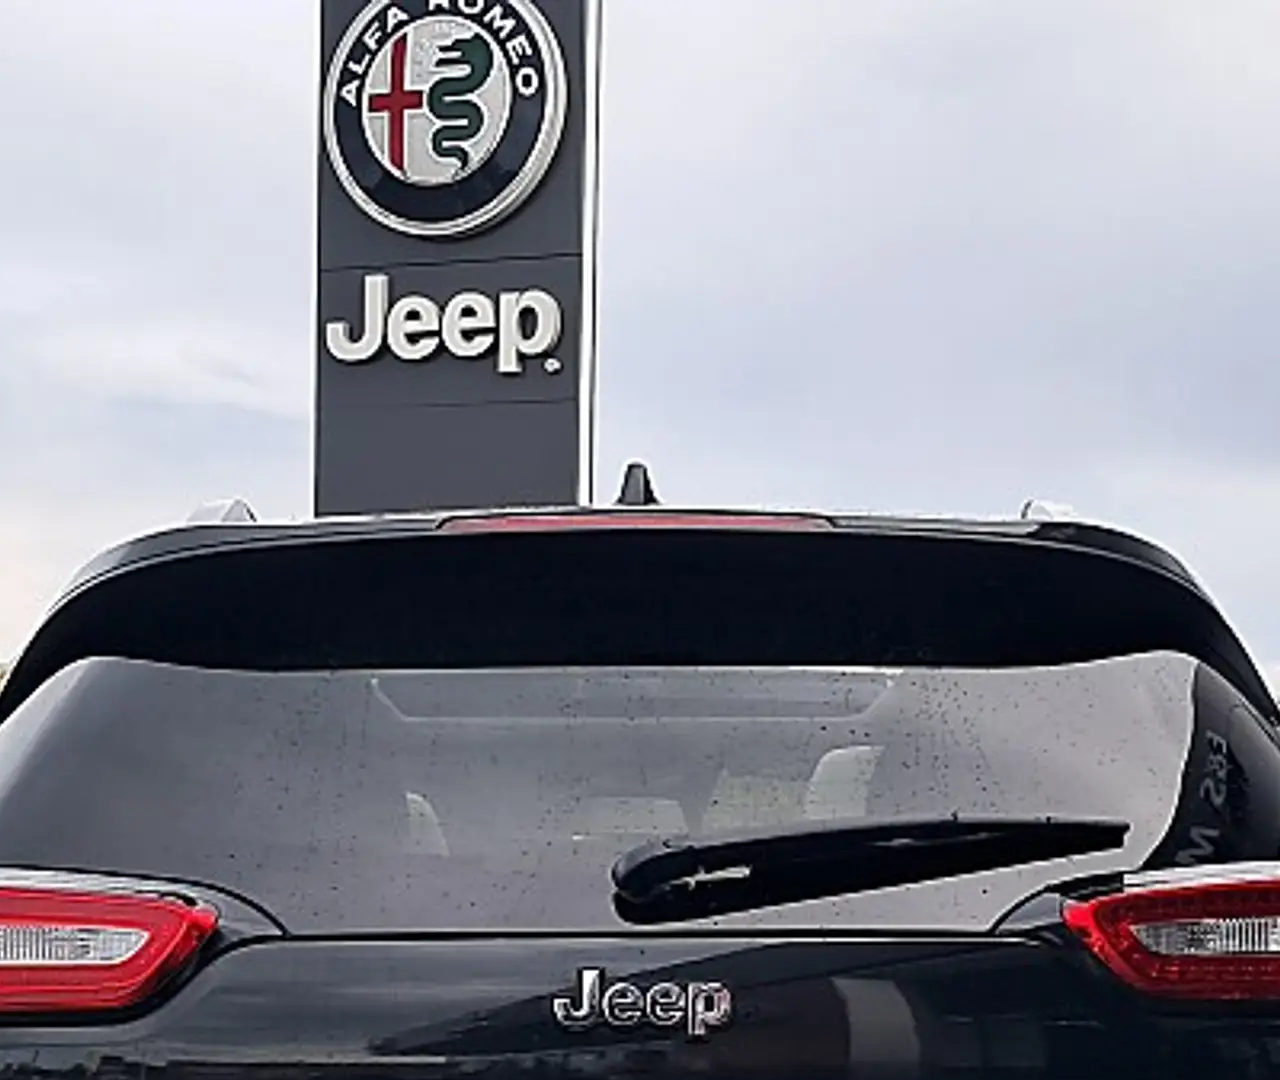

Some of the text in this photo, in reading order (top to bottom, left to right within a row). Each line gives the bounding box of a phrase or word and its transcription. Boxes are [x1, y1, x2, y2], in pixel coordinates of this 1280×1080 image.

[339, 5, 409, 107] ALFA
[325, 273, 562, 373] Jeep
[553, 967, 732, 1036] Jeep
